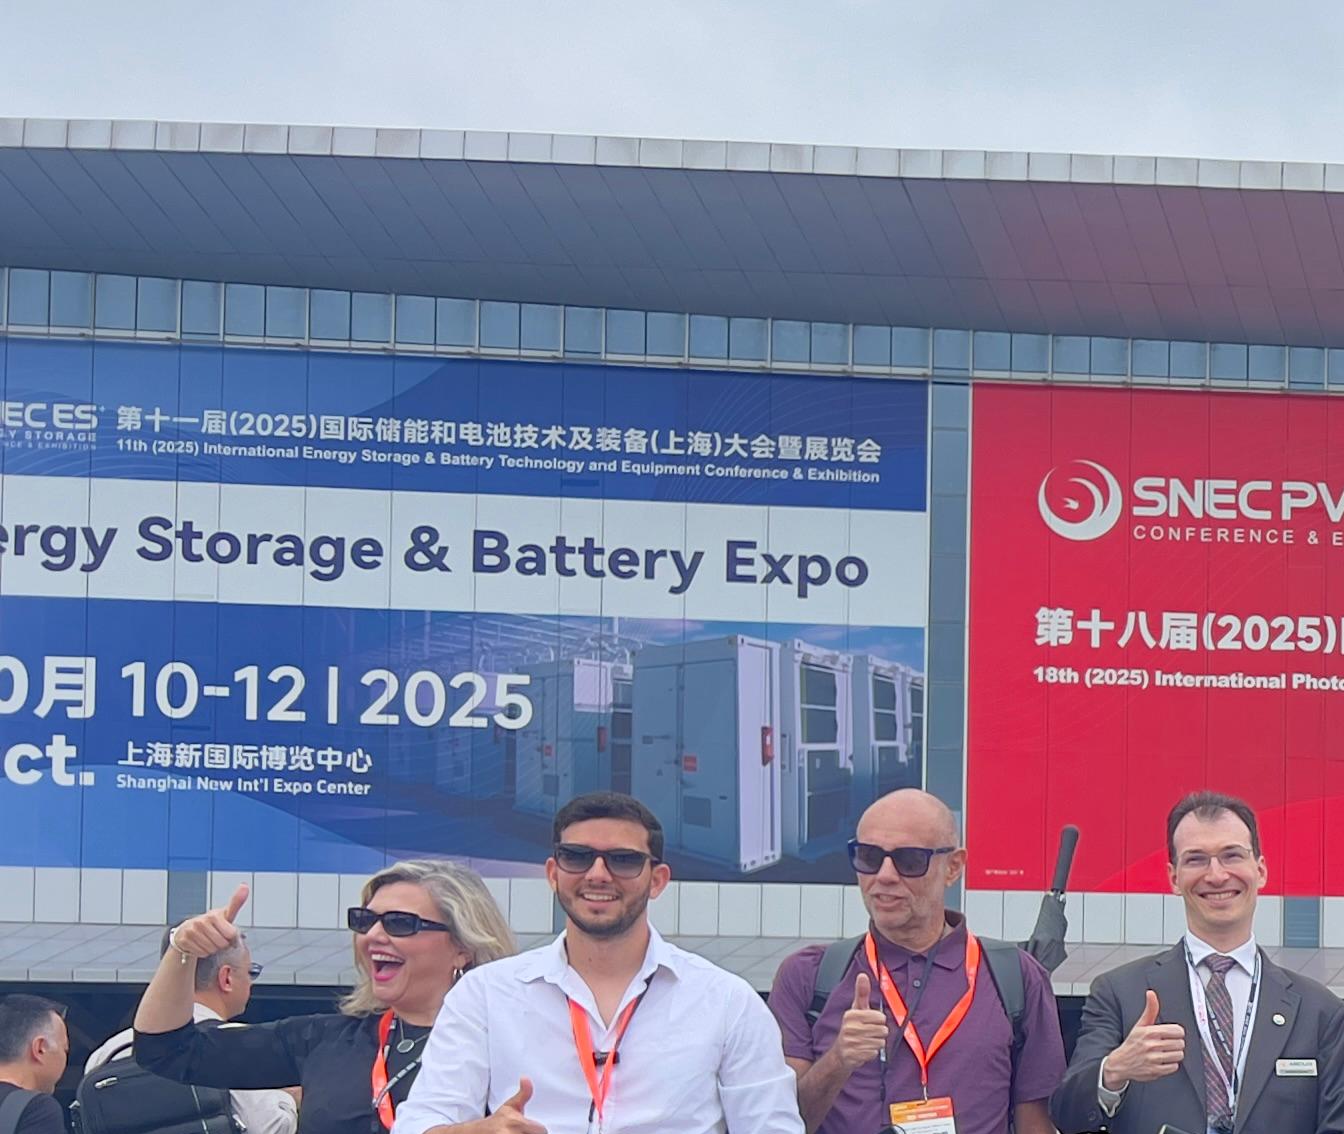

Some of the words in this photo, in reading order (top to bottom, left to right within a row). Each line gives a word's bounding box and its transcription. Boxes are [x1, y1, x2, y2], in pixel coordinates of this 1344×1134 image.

[0, 401, 47, 429] EC
[53, 403, 98, 430] ES
[25, 431, 97, 443] STORAGE
[116, 404, 882, 464] 第十一届(2025)国际储能和电池技术及装备(上海)大会暨展览会
[116, 438, 148, 453] 11th
[152, 440, 200, 457] (2025)
[203, 442, 299, 459] International
[302, 446, 357, 464] Energy
[361, 449, 421, 467] Storage
[424, 452, 436, 465] &
[440, 453, 494, 470] Battery
[499, 454, 585, 474] Technology
[589, 459, 618, 473] and
[621, 460, 701, 477] Equipment
[704, 464, 789, 481] Conference
[792, 467, 804, 481] &
[807, 468, 881, 484] Exhibition
[1132, 476, 1273, 521] SNEC
[1133, 525, 1295, 545] CONFERENCE
[1307, 530, 1320, 546] &
[135, 515, 384, 582] Storage
[404, 525, 452, 573] &
[472, 529, 705, 596] Battery
[726, 539, 870, 600] Expo
[1033, 666, 1080, 685] 18th
[1085, 668, 1150, 690] (2025)
[1155, 670, 1287, 690] International
[120, 660, 307, 722] 10-12
[359, 668, 534, 731] 2025
[117, 740, 373, 774] 上海新国际博览中心
[116, 773, 192, 794] Shanghai
[196, 776, 233, 793] New
[237, 776, 269, 794] Int'l
[274, 778, 313, 798] Expo
[316, 779, 372, 796] Center
